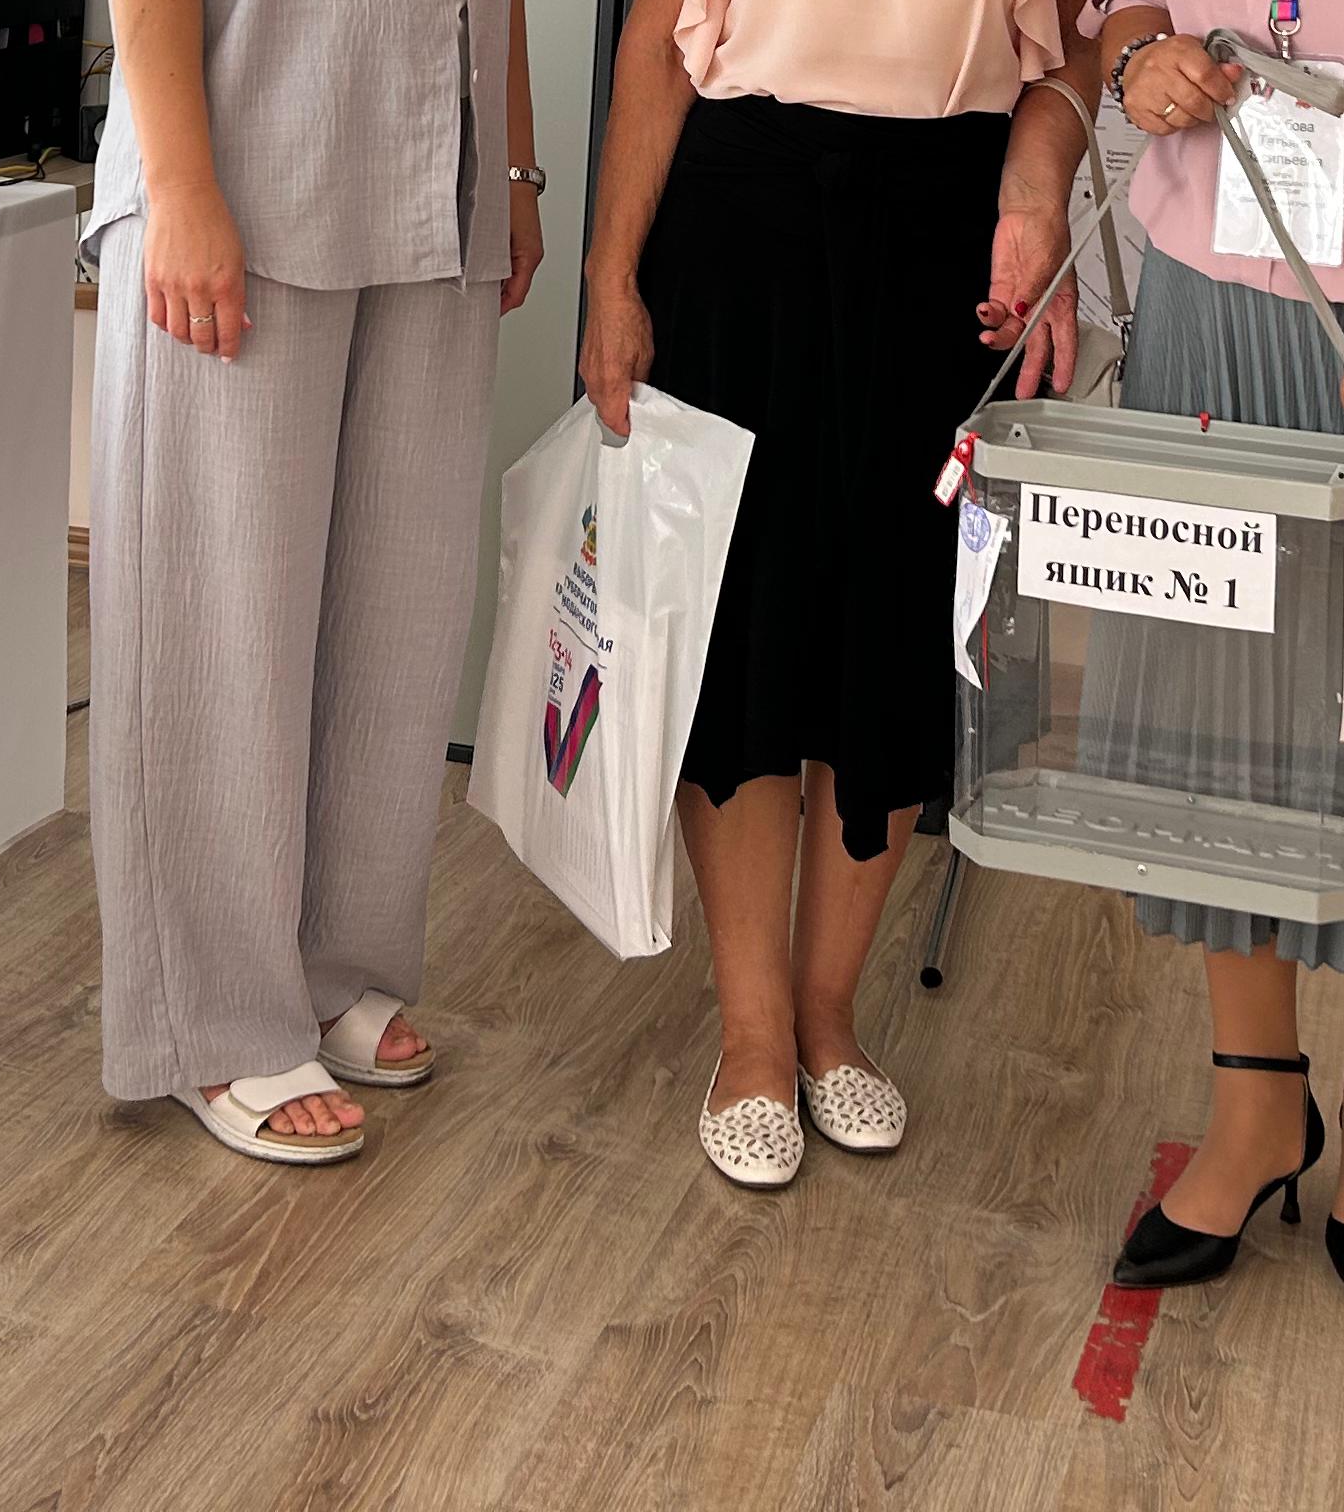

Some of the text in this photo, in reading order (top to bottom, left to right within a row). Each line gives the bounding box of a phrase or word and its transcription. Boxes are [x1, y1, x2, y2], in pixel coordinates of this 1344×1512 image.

[1030, 492, 1263, 553] Переносной
[1045, 561, 1239, 608] ящик № 1
